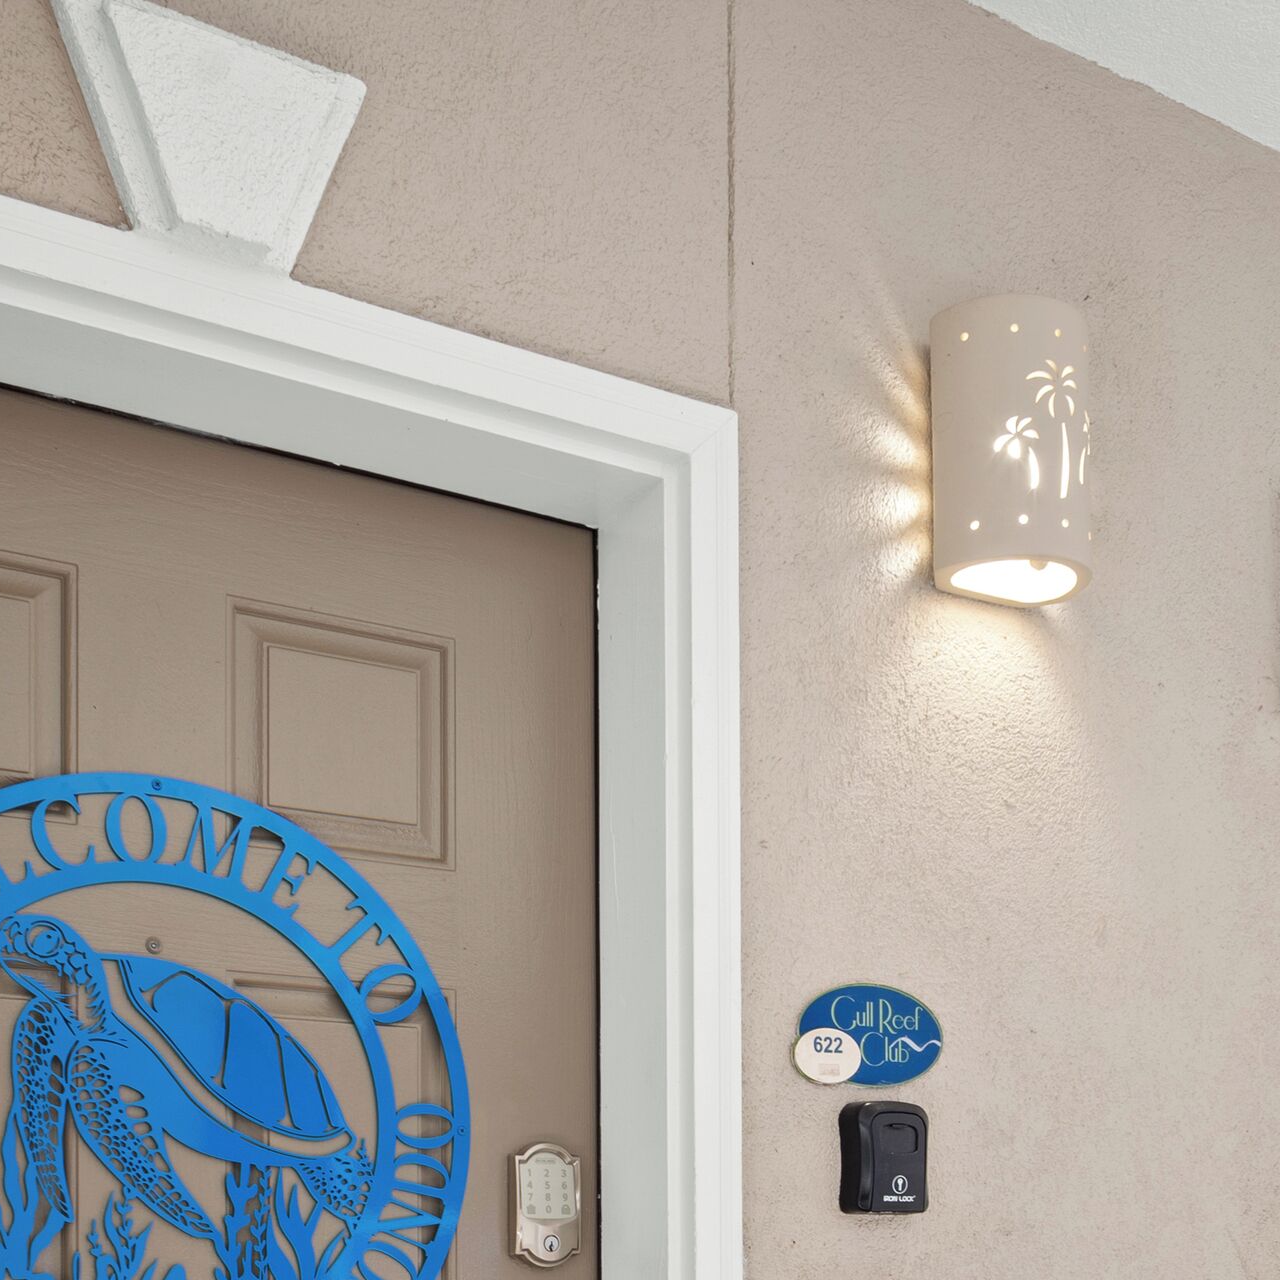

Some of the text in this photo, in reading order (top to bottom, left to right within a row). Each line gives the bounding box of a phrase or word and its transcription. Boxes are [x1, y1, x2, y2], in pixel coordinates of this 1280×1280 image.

[320, 897, 423, 1026] TO
[879, 998, 924, 1035] Reef
[813, 1036, 844, 1054] 622
[861, 1031, 910, 1067] Club
[528, 1168, 567, 1178] 1 2 3
[527, 1181, 568, 1190] 4 5 6
[528, 1193, 568, 1202] 7 8 9
[545, 1205, 552, 1214] 0
